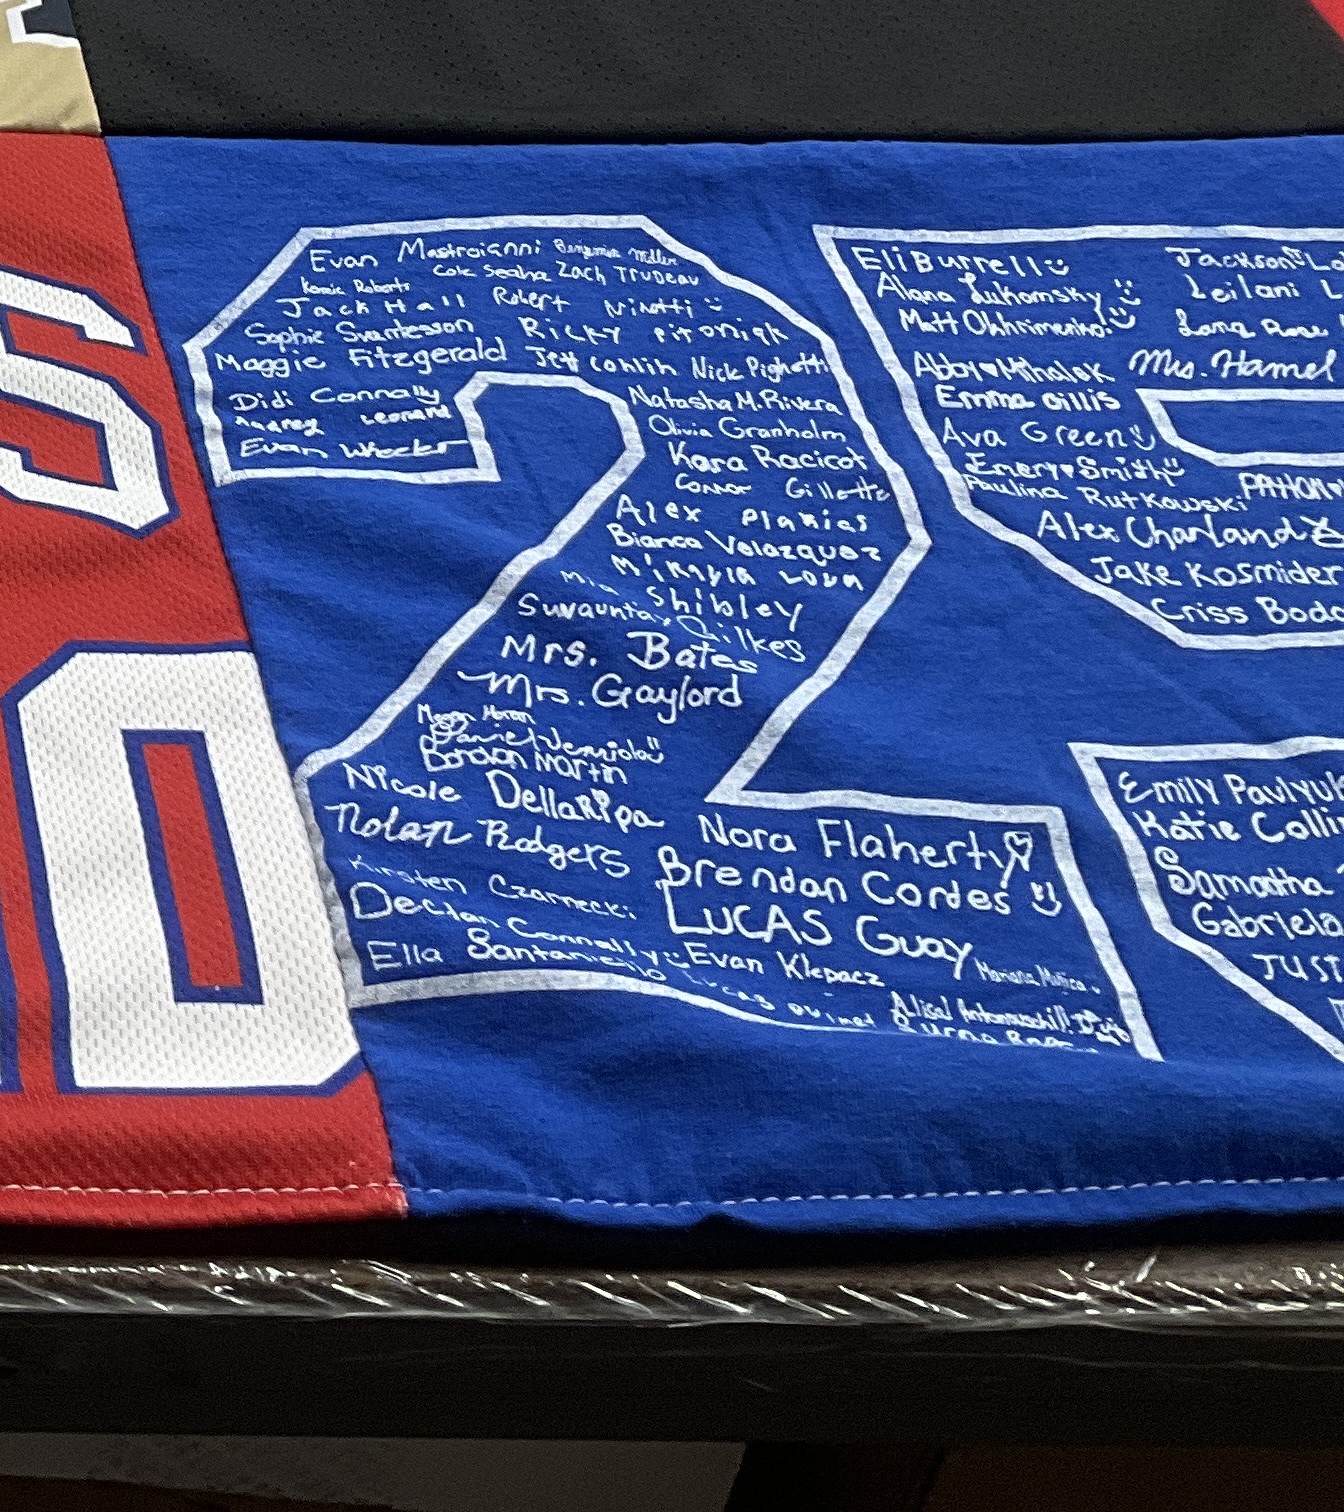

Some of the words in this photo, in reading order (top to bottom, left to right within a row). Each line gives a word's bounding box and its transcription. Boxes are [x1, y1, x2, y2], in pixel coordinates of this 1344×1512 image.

[310, 249, 379, 273] Evan
[555, 260, 607, 286] Zach
[851, 246, 907, 272] Eli
[275, 297, 370, 319] Jack
[492, 287, 571, 313] Robert
[898, 307, 960, 336] Matt
[214, 350, 327, 378] Maggie
[348, 337, 509, 375] Fitzgerald
[691, 356, 744, 381] Nick
[1211, 348, 1338, 383] Hamel
[228, 390, 294, 412] Didi
[628, 385, 733, 411] Natasha
[934, 384, 1037, 412] Emma
[647, 413, 714, 439] Olivia
[942, 416, 1007, 447] Ava
[1020, 420, 1129, 449] Green
[240, 437, 329, 460] Evan
[668, 440, 749, 473] Kara
[616, 494, 702, 526] Alex
[1037, 509, 1121, 544] Alex
[606, 522, 704, 550] Bianca
[1151, 597, 1250, 625] Criss
[499, 634, 599, 668] Mrs.
[627, 630, 759, 675] Bates
[591, 673, 743, 724] Gaylord
[342, 763, 463, 803] Nicole
[1118, 771, 1221, 806] Emily
[324, 802, 474, 849] Nolan
[476, 818, 632, 879] Rodgers
[698, 812, 798, 854] Nora
[1132, 809, 1243, 842] Katie
[656, 845, 849, 905] Brendan
[861, 870, 1013, 916] Cordes
[658, 880, 833, 947] LUCAS
[366, 939, 445, 972] Ella
[682, 940, 765, 975] Evan
